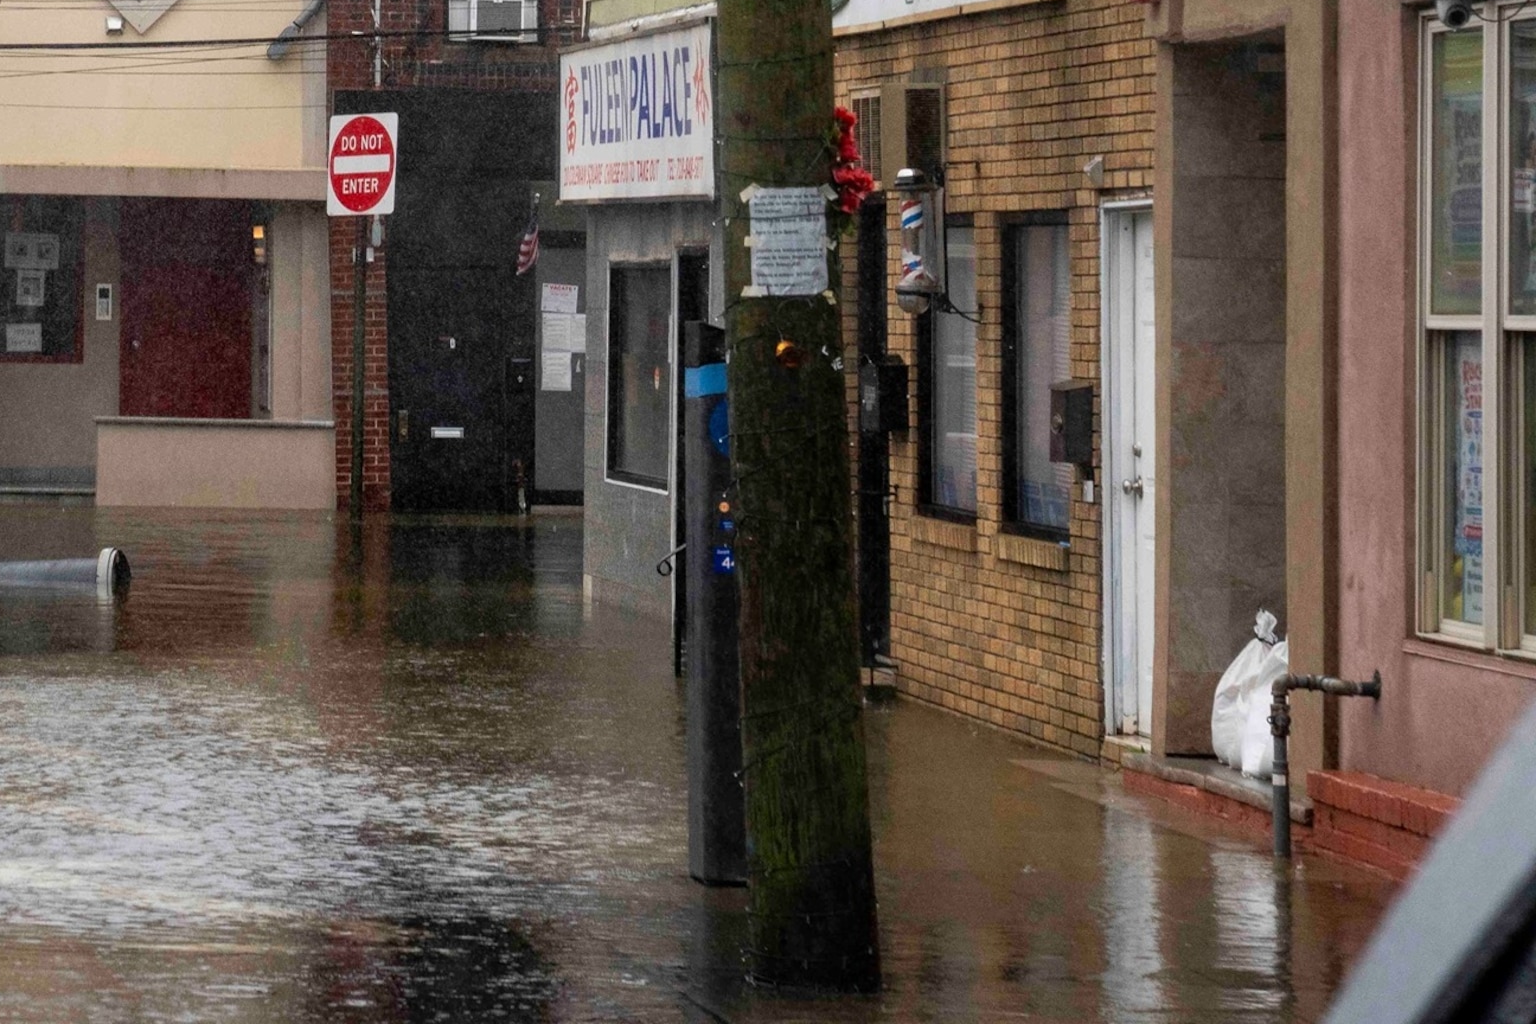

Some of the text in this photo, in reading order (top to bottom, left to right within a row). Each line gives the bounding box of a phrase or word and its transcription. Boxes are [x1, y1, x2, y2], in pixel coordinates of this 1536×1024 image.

[580, 46, 692, 147] FULEEN PALACE
[341, 134, 384, 151] DO NOT
[342, 178, 379, 194] ENTER
